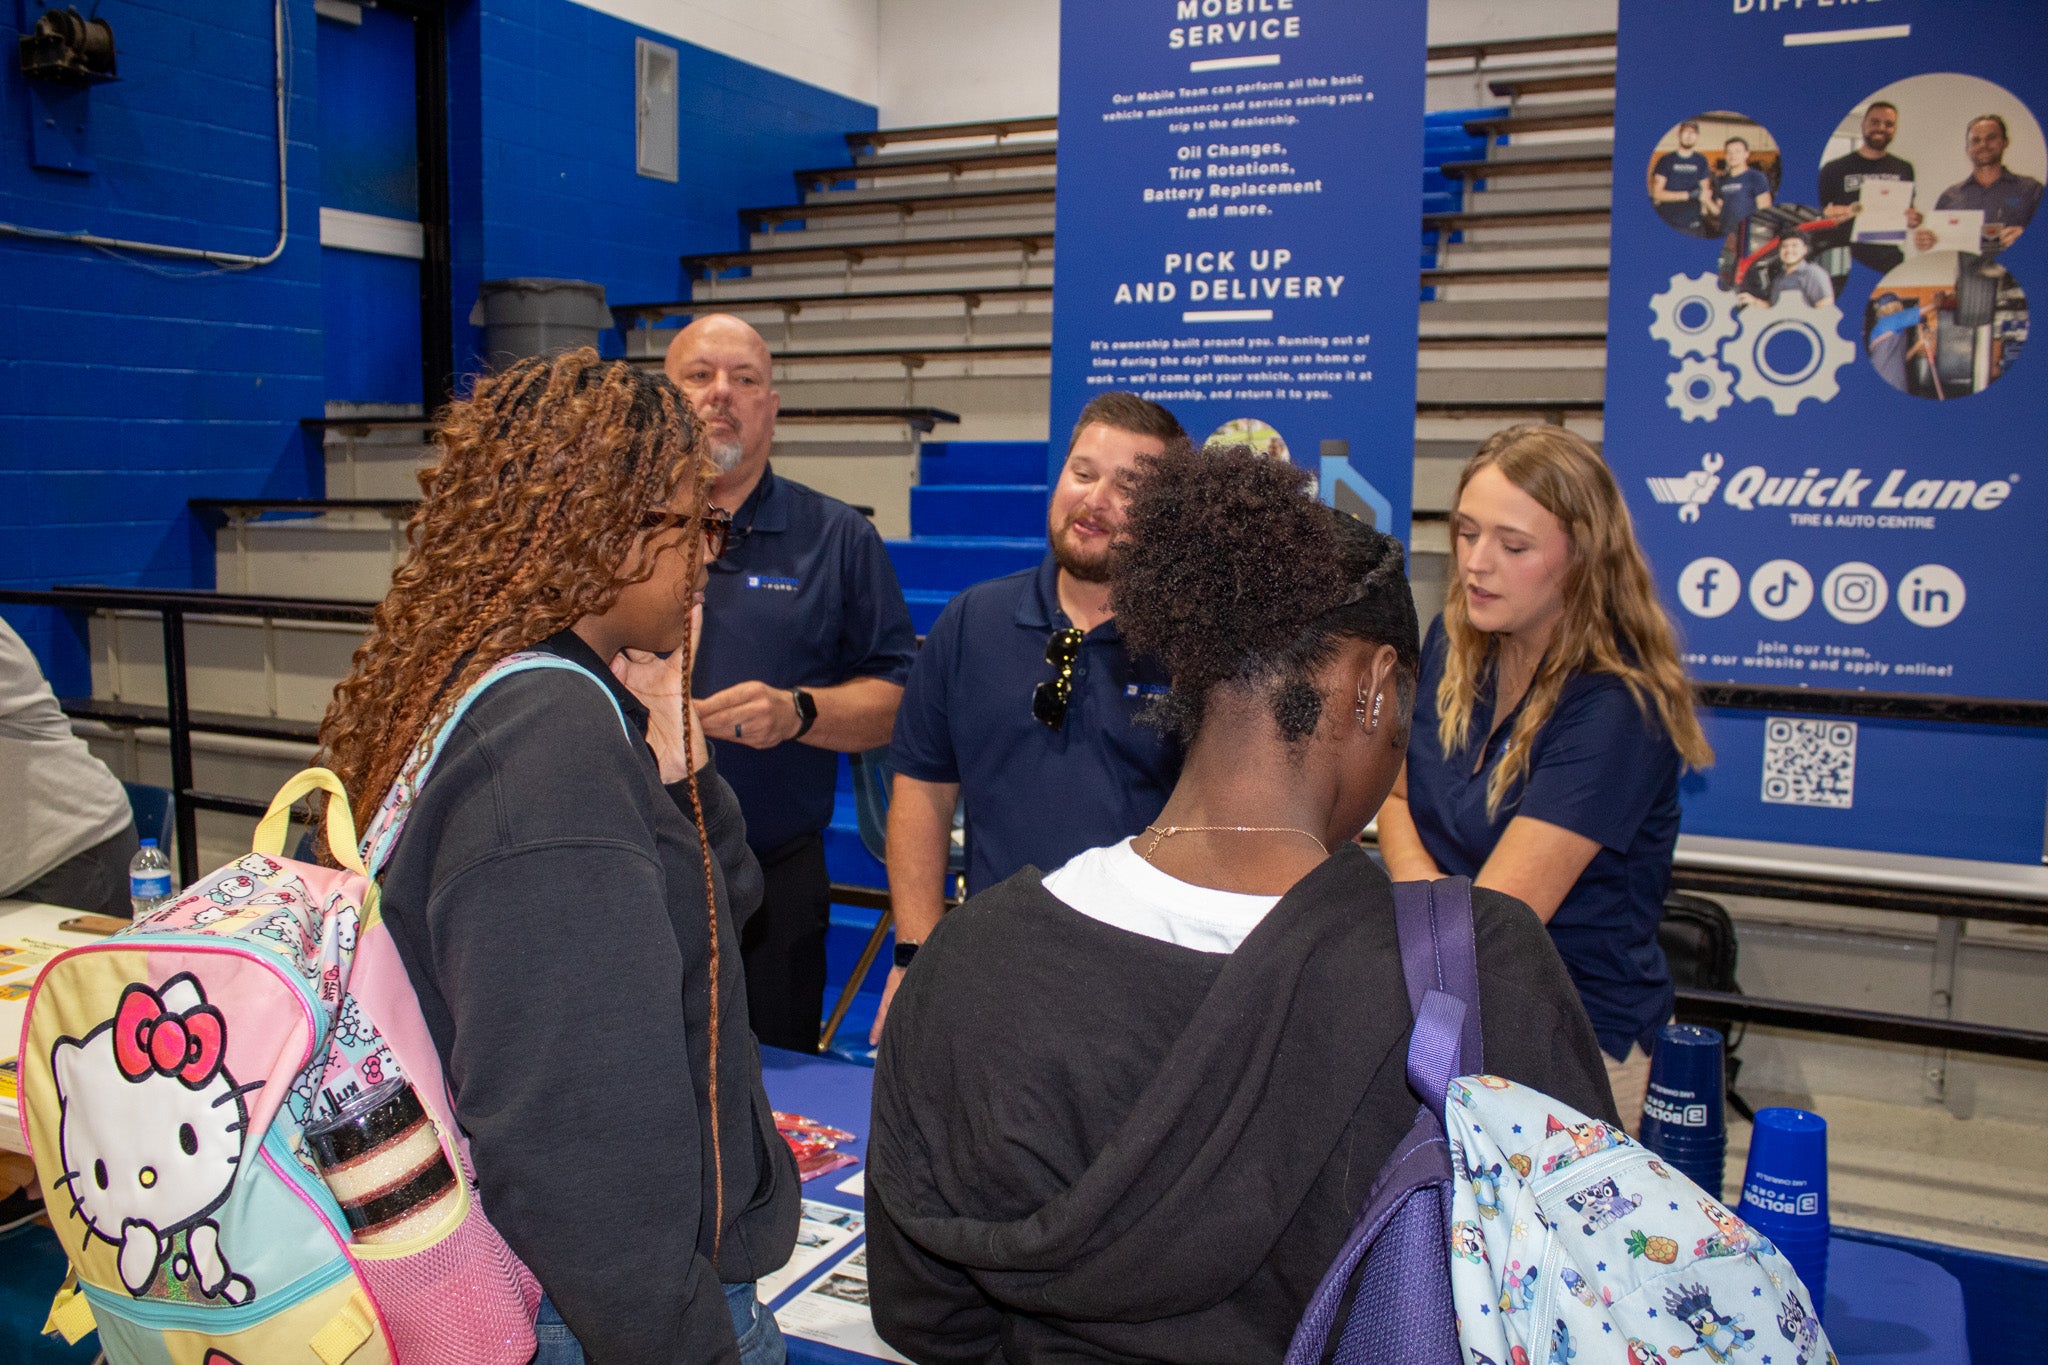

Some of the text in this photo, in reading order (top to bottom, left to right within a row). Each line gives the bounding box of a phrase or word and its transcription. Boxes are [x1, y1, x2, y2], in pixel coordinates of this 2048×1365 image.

[1169, 16, 1300, 49] SERVICE
[1112, 74, 1364, 104] Our Mobile Team can perform all the basic
[1102, 92, 1374, 122] vehicle maintenance and service saving you a
[1168, 114, 1300, 134] trip to the dealership.
[1177, 143, 1287, 160] Oil Changes,
[1168, 161, 1295, 180] Tire Rotations,
[1143, 179, 1322, 203] Battery Replacement
[1187, 203, 1272, 219] and more.
[1164, 248, 1292, 274] PICK UP
[1114, 276, 1344, 304] AND DELIVERY
[1090, 334, 1370, 350] It's ownership built around you. Running out of
[1092, 353, 1366, 368] time during the day? Whether you are home or
[1086, 374, 1114, 384] work
[1130, 372, 1157, 383] we'll
[1160, 374, 1190, 382] come
[1193, 372, 1213, 385] get
[1216, 373, 1242, 384] your
[1246, 372, 1294, 383] vehicle,
[1297, 370, 1342, 382] service
[1346, 370, 1356, 382] it
[1358, 371, 1372, 382] at
[1142, 389, 1207, 401] dealership,
[1210, 389, 1232, 400] and
[1234, 389, 1272, 400] return
[1276, 388, 1286, 399] it
[1289, 389, 1302, 400] to
[1305, 390, 1332, 402] you.
[1724, 466, 2011, 510] Quick Lane
[1790, 513, 1936, 530] TIRE & AUTO CENTRE
[1758, 640, 1871, 659] join our team,
[1711, 654, 1738, 666] our
[1742, 655, 1804, 669] website
[1808, 659, 1840, 671] and
[1844, 661, 1890, 676] apply
[1894, 662, 1953, 677] online!
[1744, 1190, 1795, 1214] BOLTON
